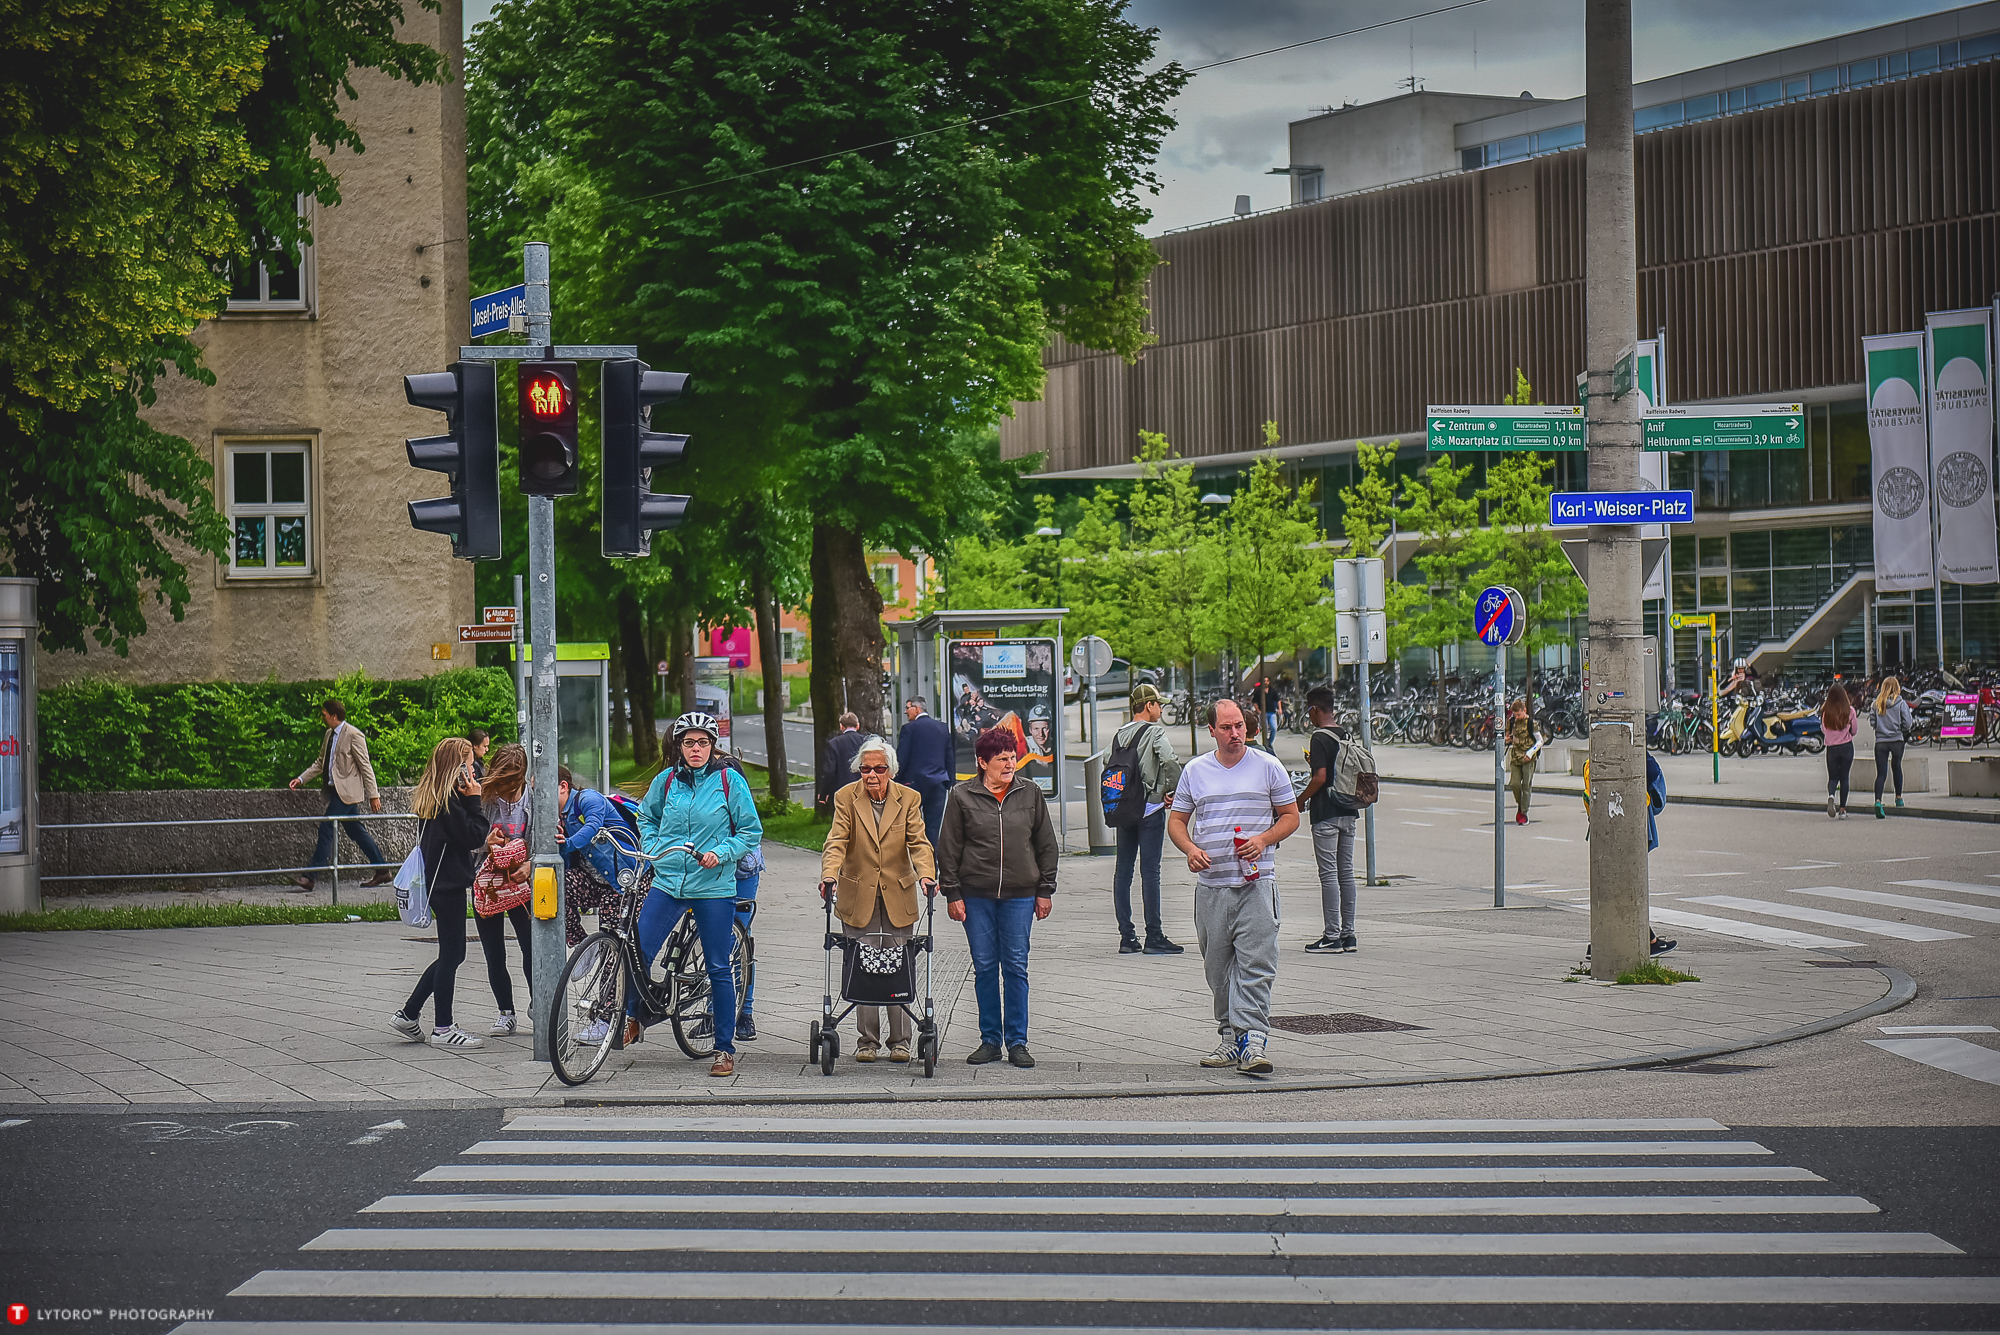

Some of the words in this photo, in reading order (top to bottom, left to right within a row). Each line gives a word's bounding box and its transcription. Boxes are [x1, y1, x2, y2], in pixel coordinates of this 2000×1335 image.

[1668, 408, 1687, 416] Radweg
[1448, 421, 1486, 431] Zentrum
[1516, 422, 1548, 430] Mozartradweg
[1554, 421, 1566, 432] 1,1
[1568, 421, 1582, 431] km
[1646, 422, 1666, 432] Anif
[1717, 422, 1750, 430] Mozartradweg
[1448, 435, 1500, 447] Mozartplatz
[1516, 437, 1548, 445] Tauernradweg
[1552, 436, 1566, 447] 0,9
[1568, 436, 1582, 446] km
[1647, 436, 1691, 447] Hellbrunn
[1717, 436, 1750, 444] Tauernradweg
[1754, 434, 1768, 446] 3,9
[1770, 434, 1784, 444] km
[1557, 499, 1687, 517] Karl-Weiser-Platz
[471, 629, 511, 638] Künstlerhaus
[983, 685, 999, 693] Der
[1001, 684, 1049, 694] Geburtstag
[1102, 780, 1124, 791] adidas
